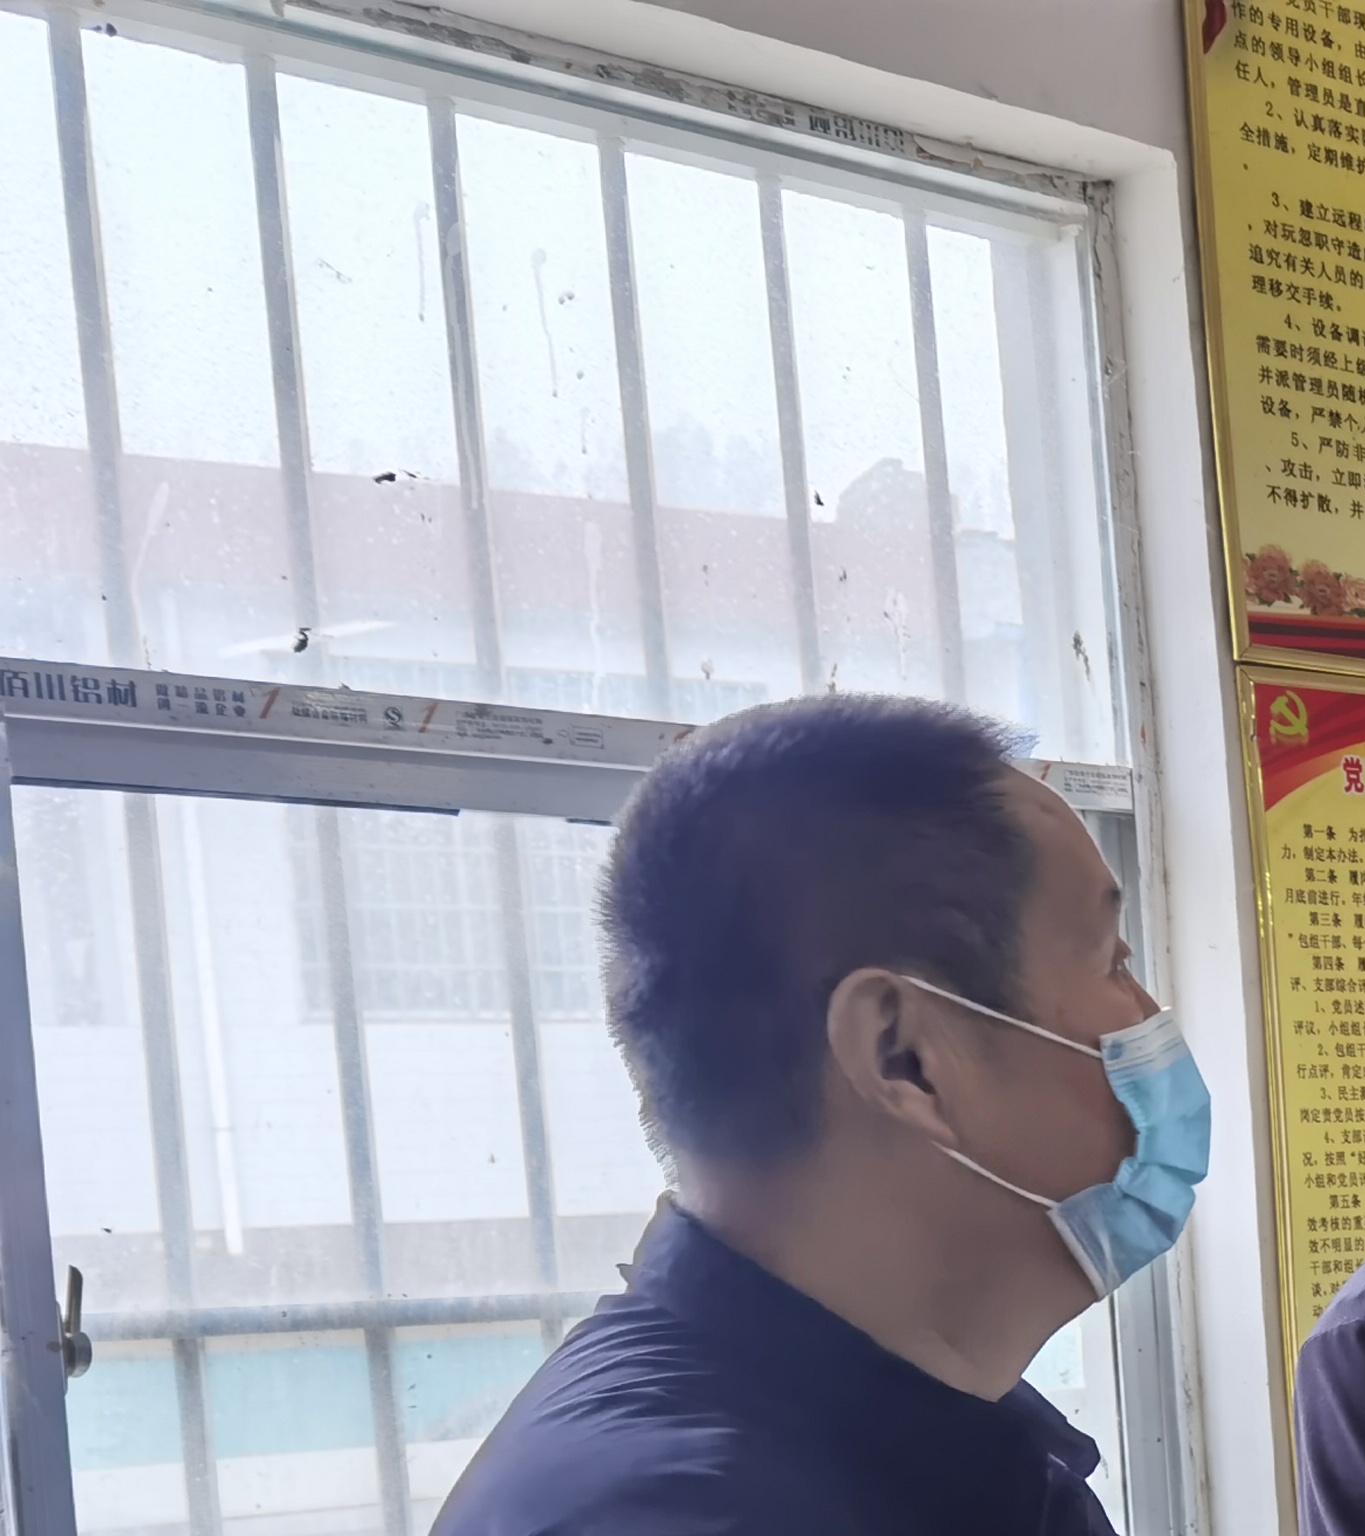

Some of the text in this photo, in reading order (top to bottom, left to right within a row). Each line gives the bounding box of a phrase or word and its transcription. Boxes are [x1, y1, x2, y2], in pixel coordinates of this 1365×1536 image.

[1302, 823, 1337, 841] 第一条
[1304, 867, 1338, 884] 第二条
[1309, 911, 1342, 928] 第三条
[1312, 956, 1345, 971] 第四条
[1329, 1194, 1361, 1209] 第五条
